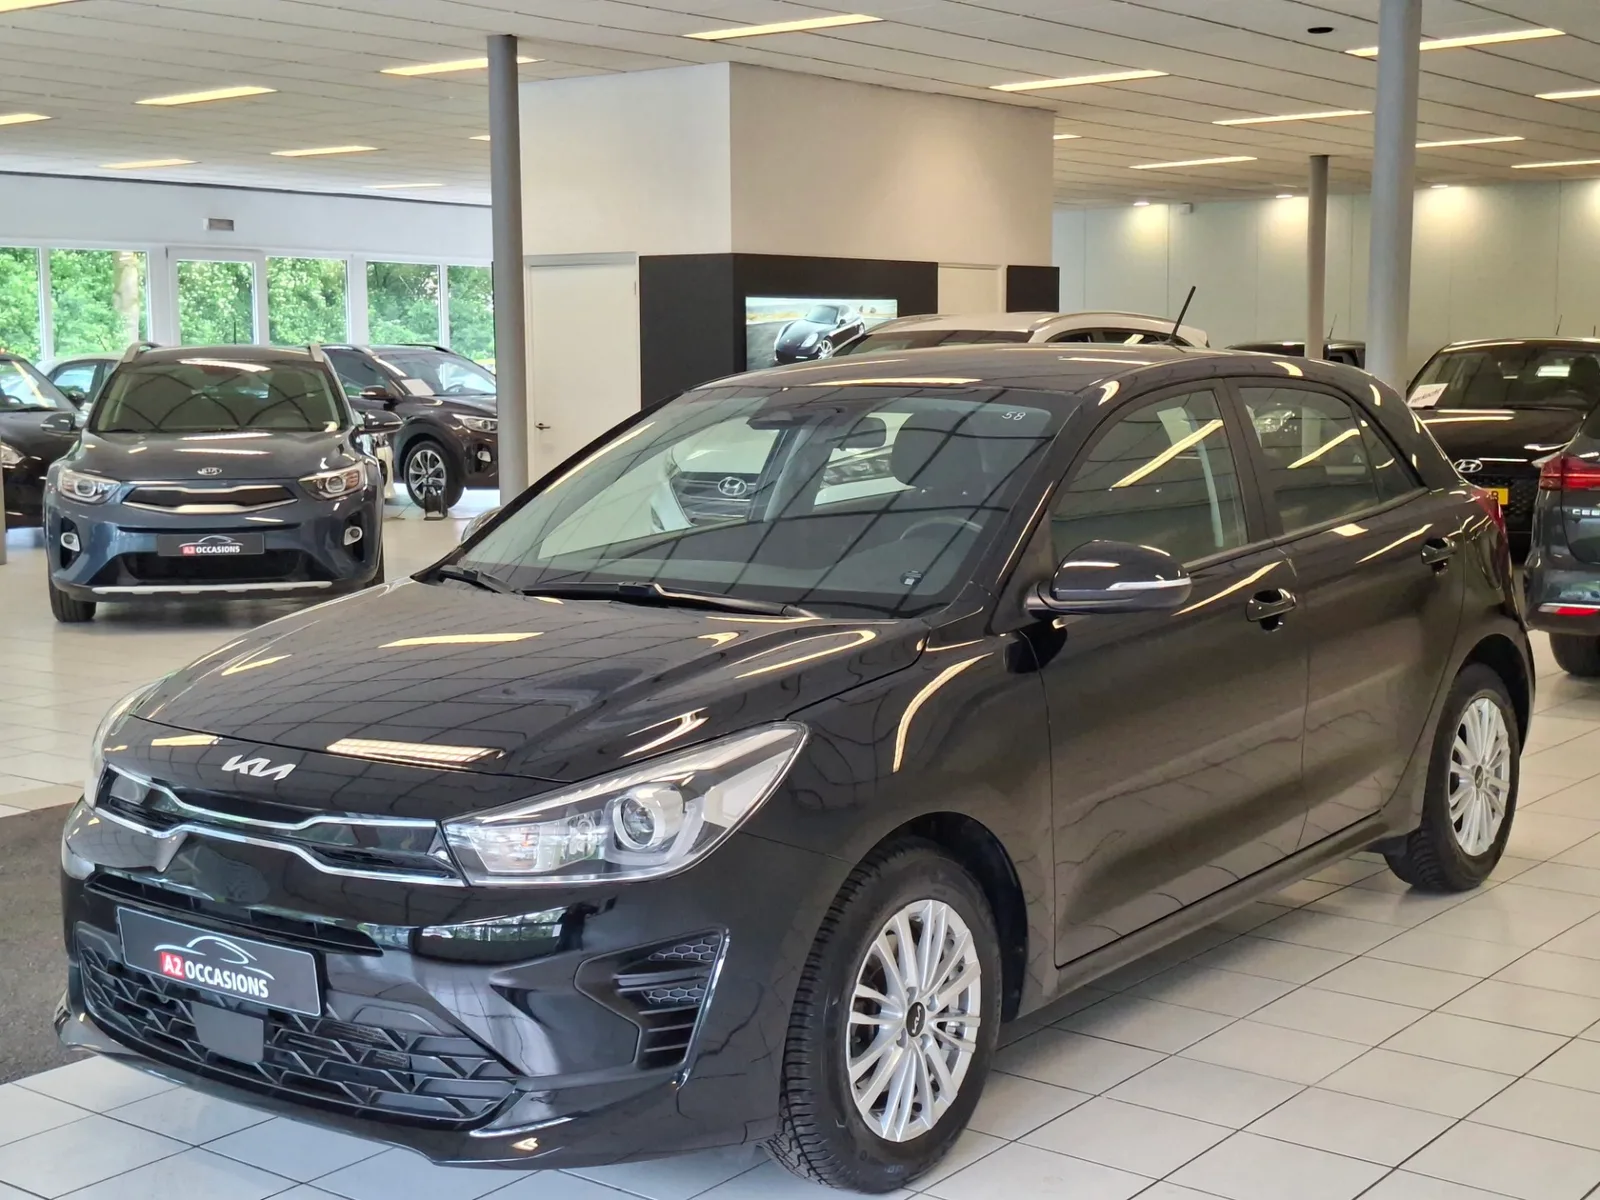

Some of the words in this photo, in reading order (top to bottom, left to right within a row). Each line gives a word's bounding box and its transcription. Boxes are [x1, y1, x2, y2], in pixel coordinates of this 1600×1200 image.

[1001, 411, 1026, 421] 58
[196, 545, 240, 554] OCCASIONS
[221, 754, 297, 780] KIA
[185, 960, 269, 999] OCCASIONS
